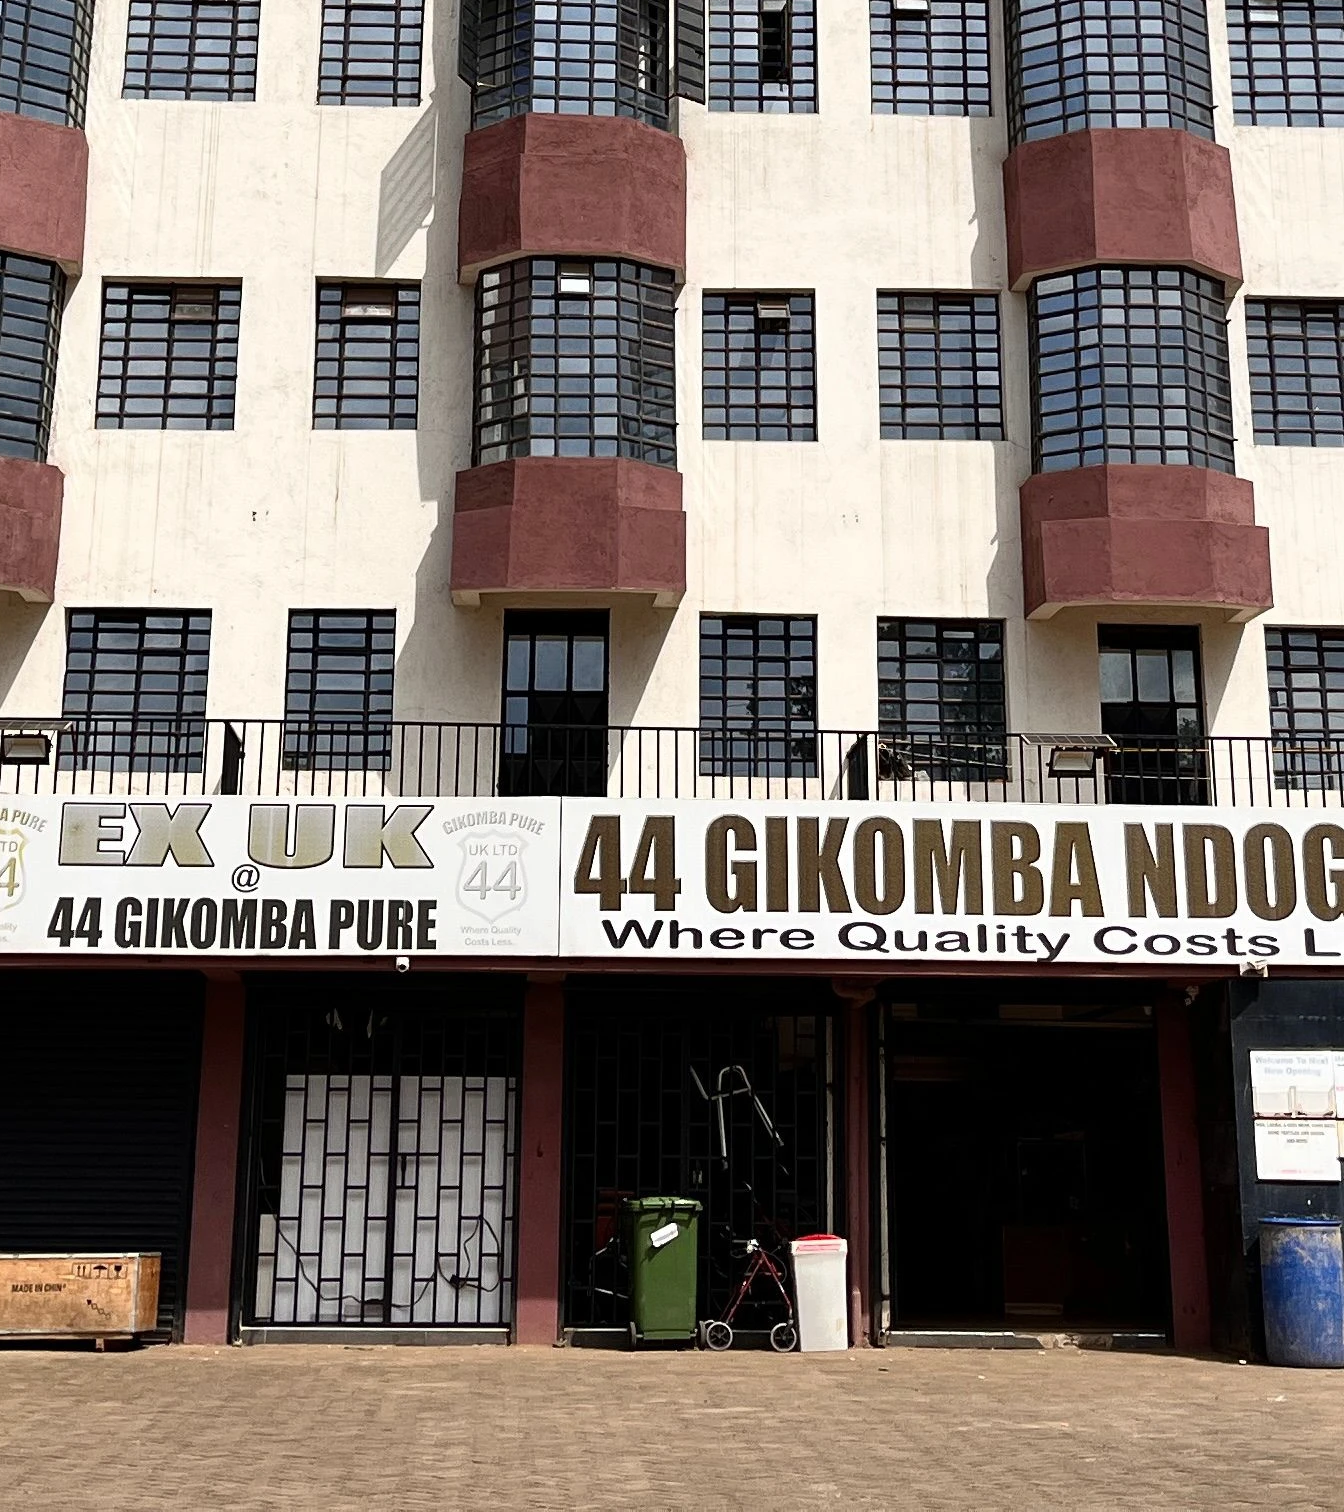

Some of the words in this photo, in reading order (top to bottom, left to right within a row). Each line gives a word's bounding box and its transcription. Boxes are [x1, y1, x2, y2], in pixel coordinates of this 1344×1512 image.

[11, 809, 48, 833] PURE
[442, 811, 506, 835] GIKOMBA
[508, 813, 546, 836] PURE
[58, 802, 213, 867] EX
[248, 803, 434, 869] UK
[469, 844, 489, 856] UK
[493, 844, 518, 856] LTD
[231, 864, 261, 893] @
[573, 814, 681, 912] 44
[704, 814, 1105, 918] GIKOMBA
[463, 860, 522, 900] 44
[47, 897, 102, 948] 44
[114, 897, 316, 950] GIKOMBA
[328, 899, 438, 951] PURE
[461, 926, 489, 934] Where
[490, 926, 522, 936] Quality
[464, 938, 489, 946] Costs
[601, 919, 815, 951] Where
[837, 920, 1071, 962] Quality
[1093, 925, 1281, 957] Costs
[11, 1284, 33, 1293] MADE
[35, 1284, 43, 1292] IN
